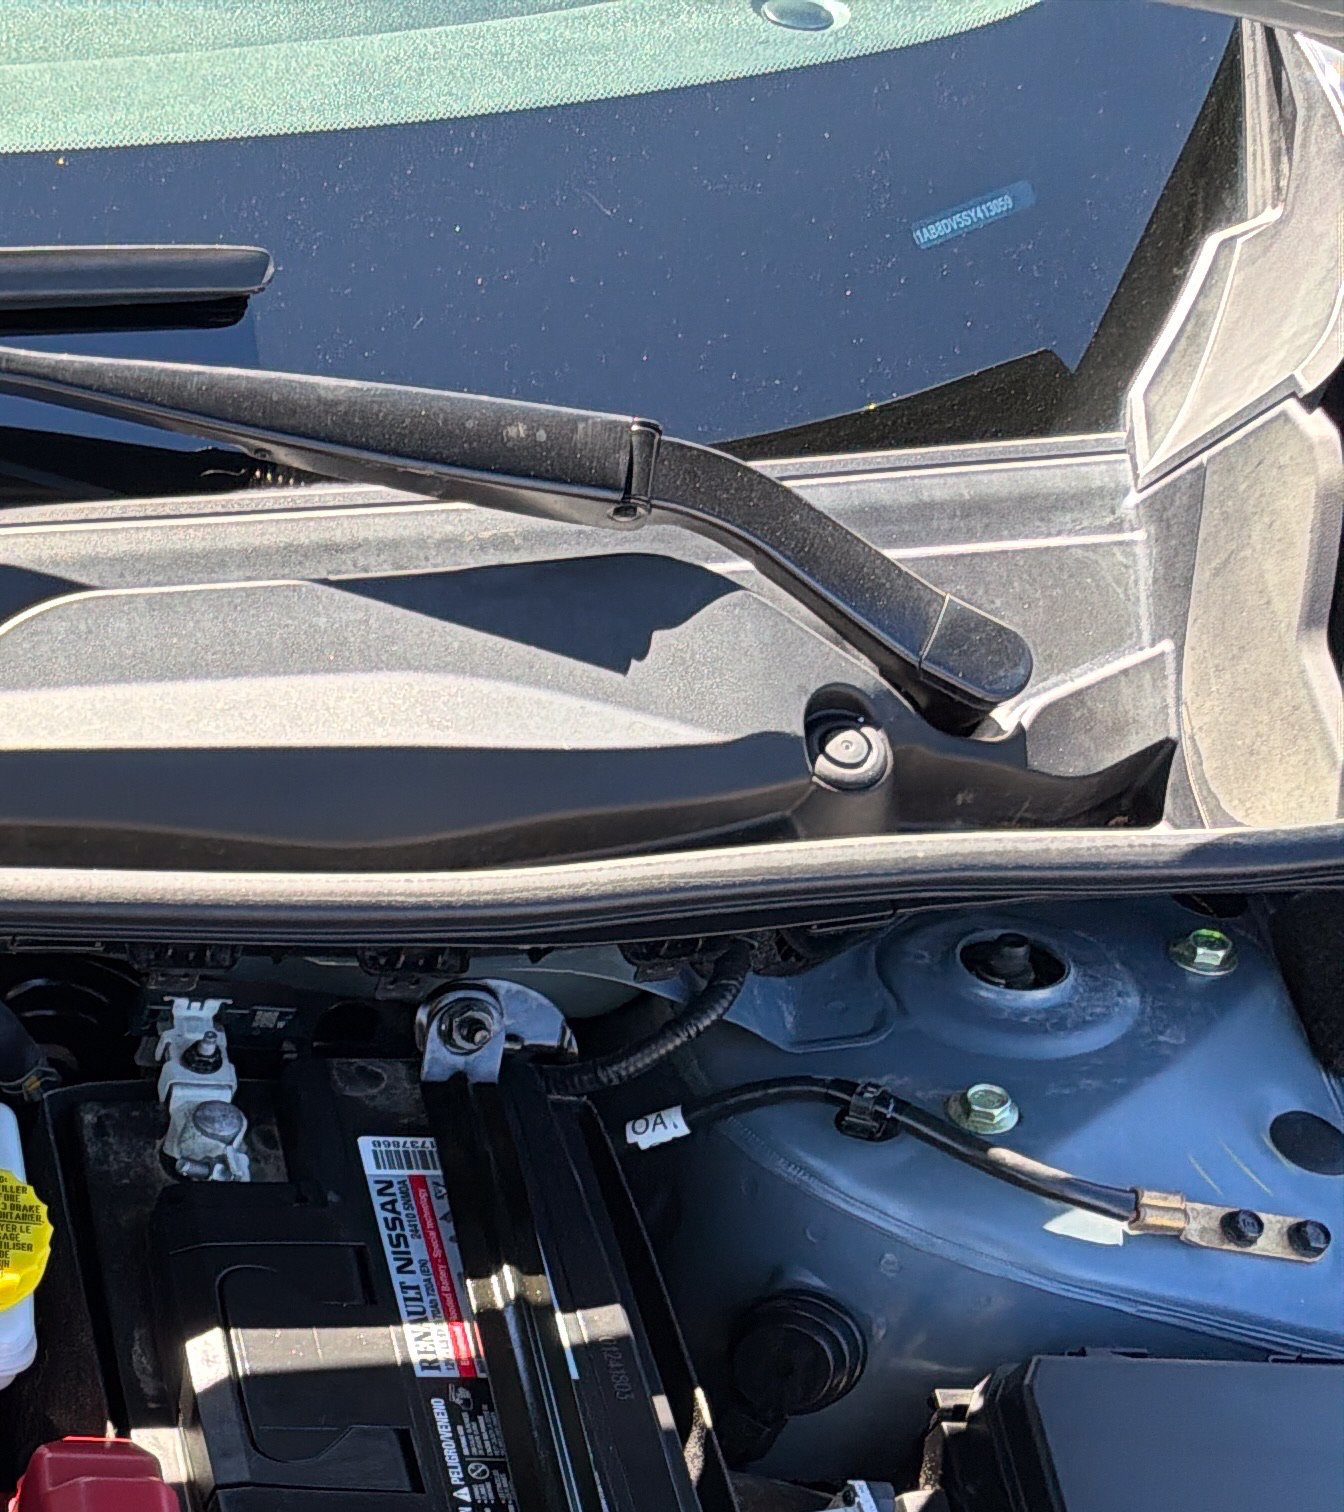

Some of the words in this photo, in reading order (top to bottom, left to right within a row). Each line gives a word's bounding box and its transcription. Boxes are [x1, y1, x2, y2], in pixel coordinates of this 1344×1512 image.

[1, 1202, 8, 1210] 3
[10, 1203, 41, 1213] BRAKE
[20, 1225, 32, 1234] LE
[374, 1179, 416, 1275] NISSAN
[431, 1398, 465, 1486] PELIGRO/VENENO
